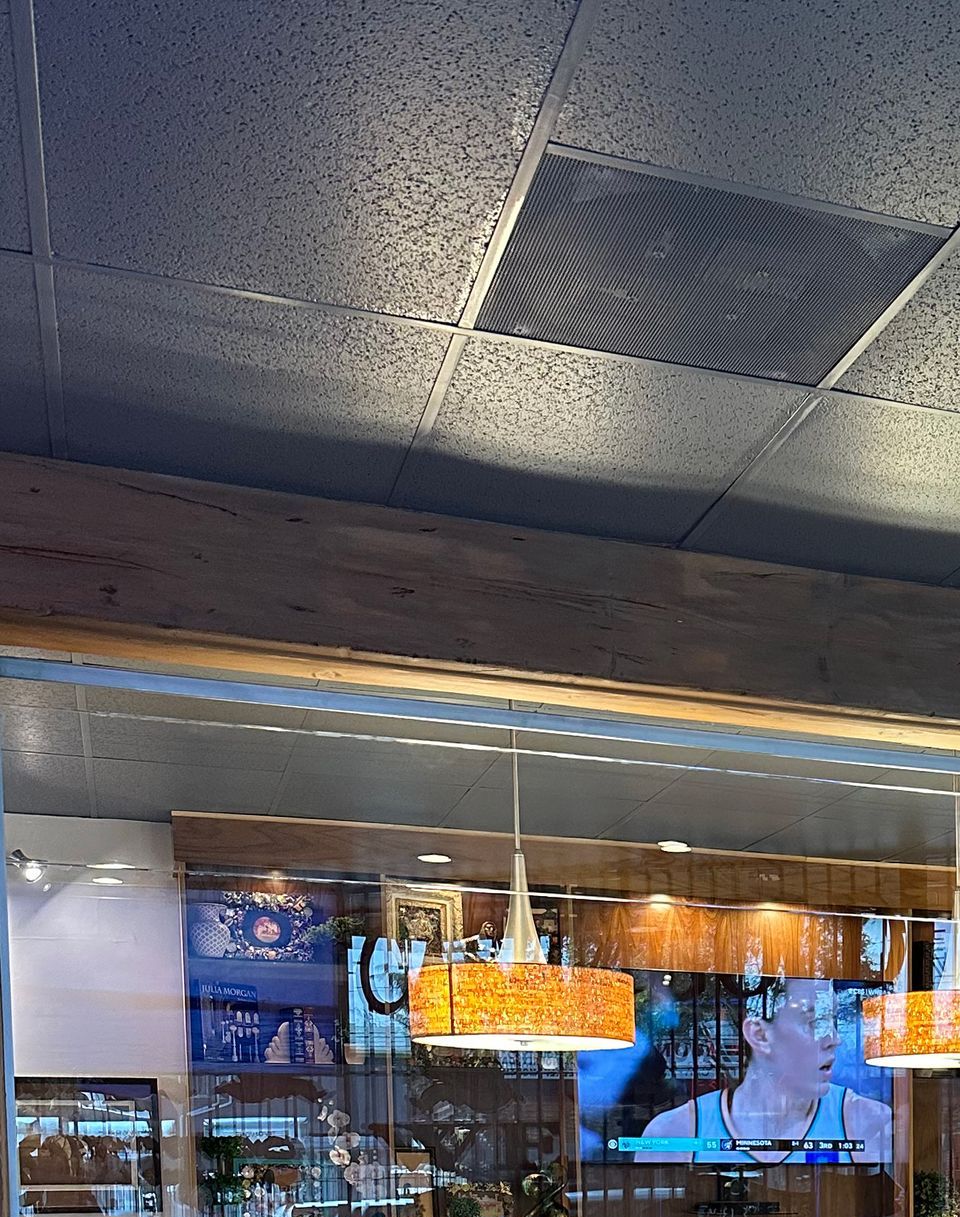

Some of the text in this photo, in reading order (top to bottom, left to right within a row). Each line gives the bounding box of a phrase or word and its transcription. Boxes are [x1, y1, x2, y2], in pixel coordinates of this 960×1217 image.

[202, 984, 257, 998] JULIA MORGAN
[706, 1141, 717, 1149] 55
[803, 1141, 814, 1149] 63
